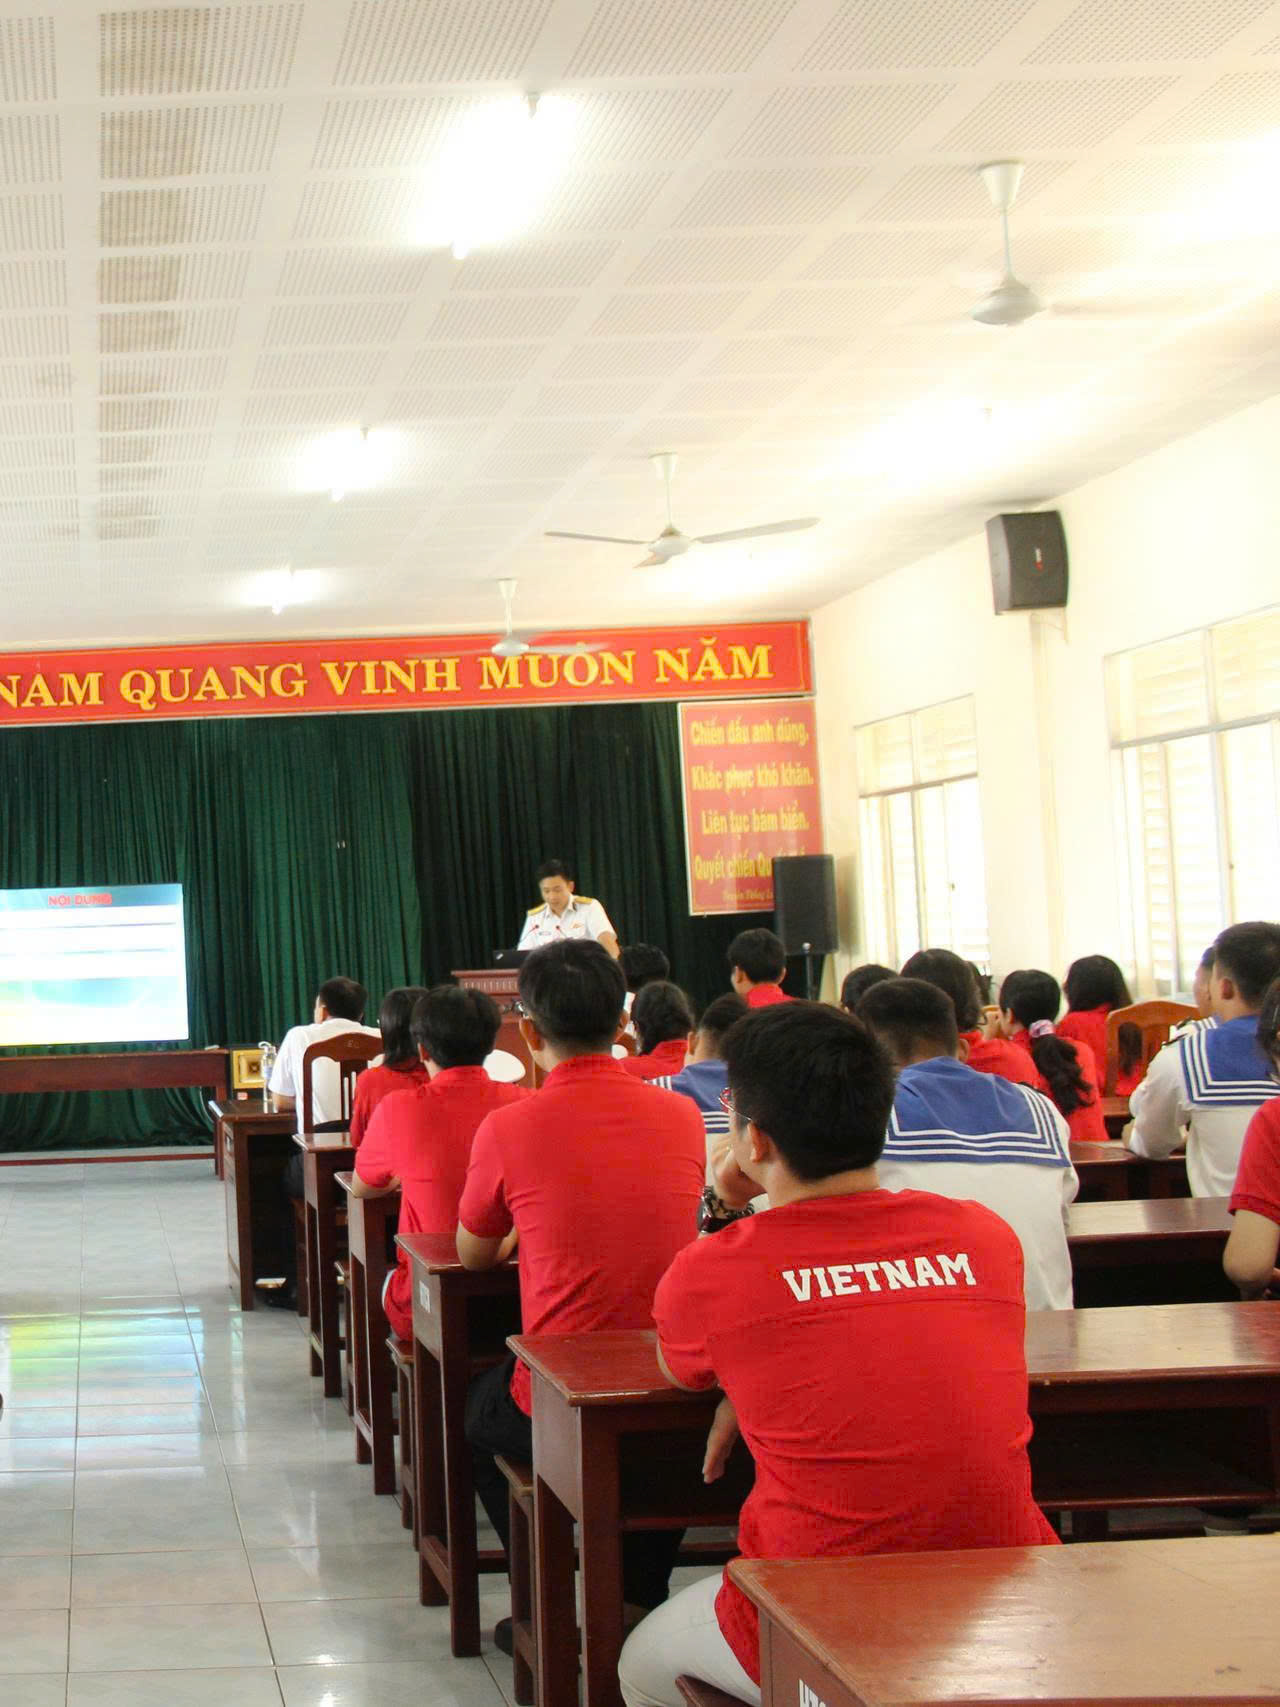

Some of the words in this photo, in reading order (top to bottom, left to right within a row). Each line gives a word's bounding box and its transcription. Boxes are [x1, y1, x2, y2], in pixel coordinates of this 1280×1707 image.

[119, 663, 308, 711] QUANG
[320, 657, 462, 696] VINH
[653, 636, 775, 683] NĂM
[751, 720, 774, 743] anh
[783, 1253, 977, 1302] VIETNAM
